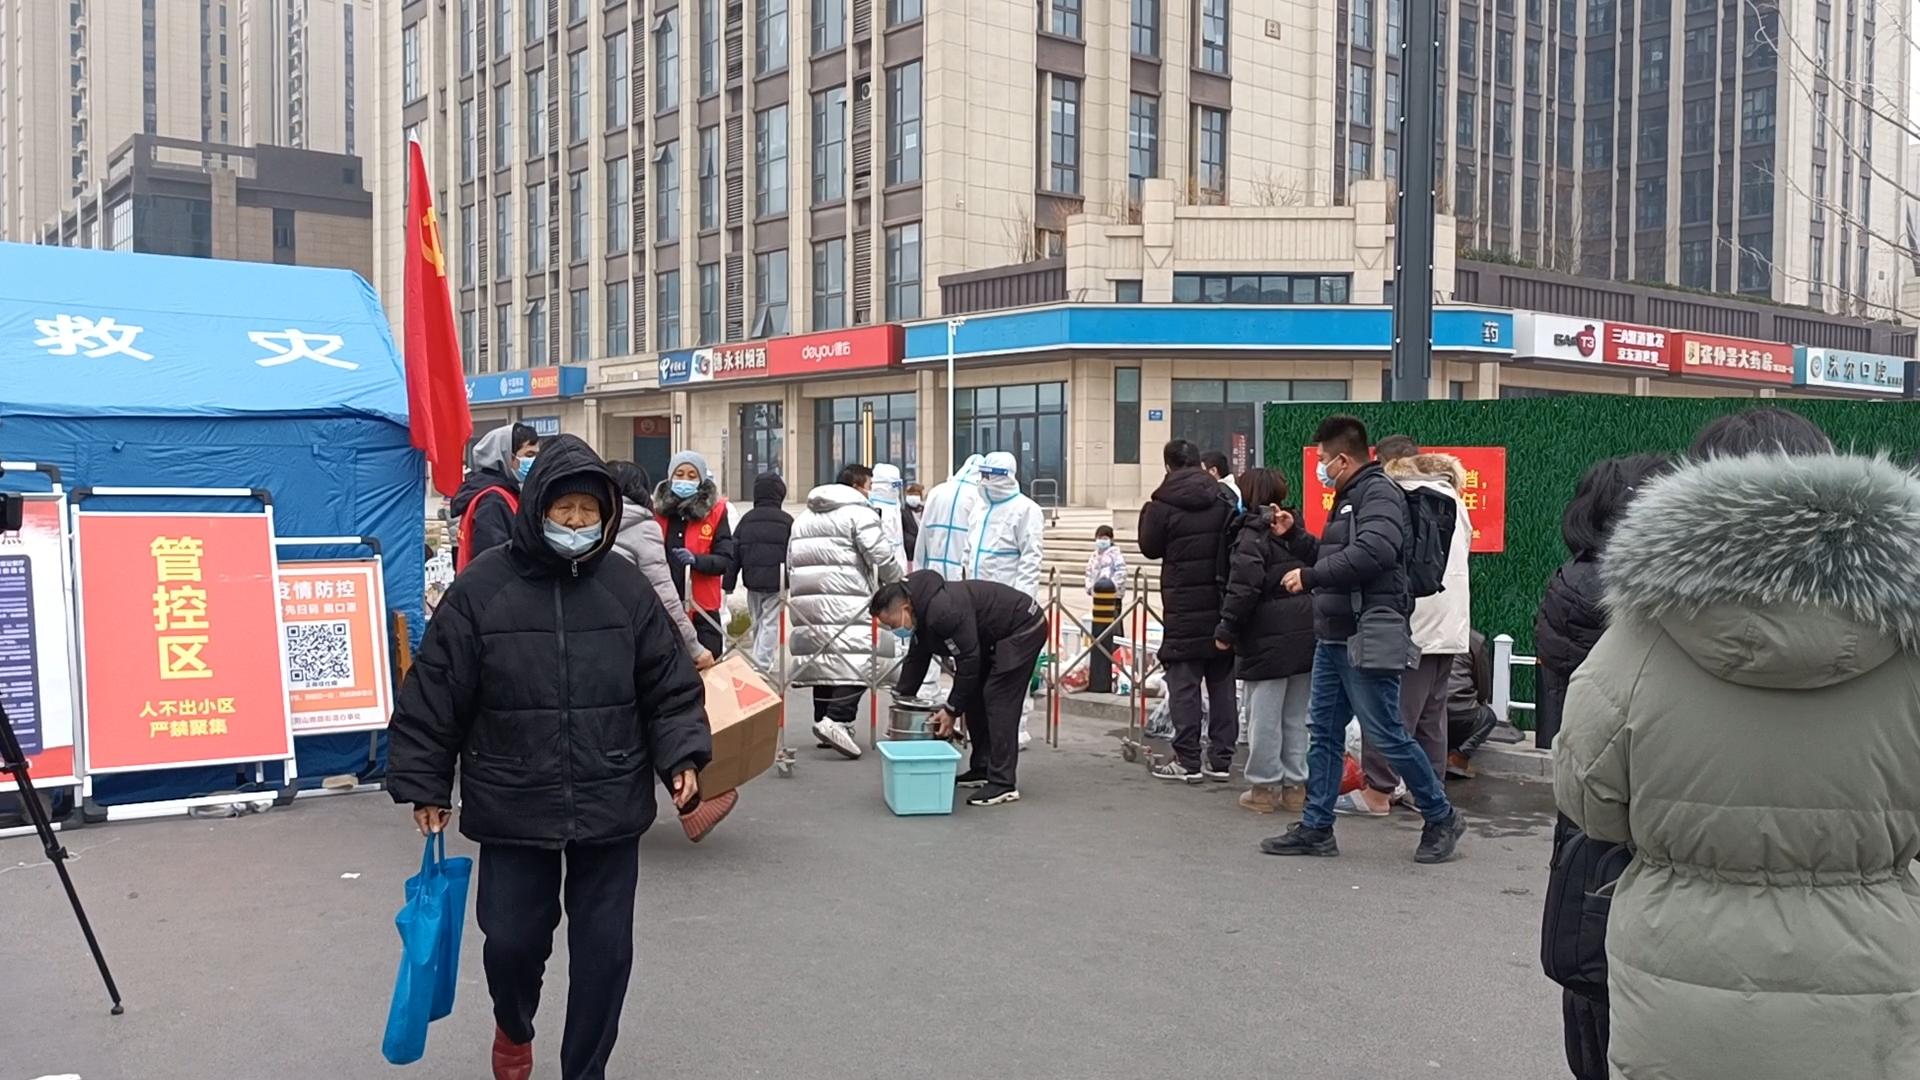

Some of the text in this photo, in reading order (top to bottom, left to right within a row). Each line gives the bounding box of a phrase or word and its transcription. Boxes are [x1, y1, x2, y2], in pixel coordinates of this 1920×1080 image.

[34, 313, 359, 371] 救灾
[1483, 320, 1499, 343] 药
[1700, 344, 1773, 372] 张仲景大药房
[150, 536, 213, 680] 管控区
[139, 697, 236, 718] 人不出小区
[150, 718, 228, 739] 严禁聚集
